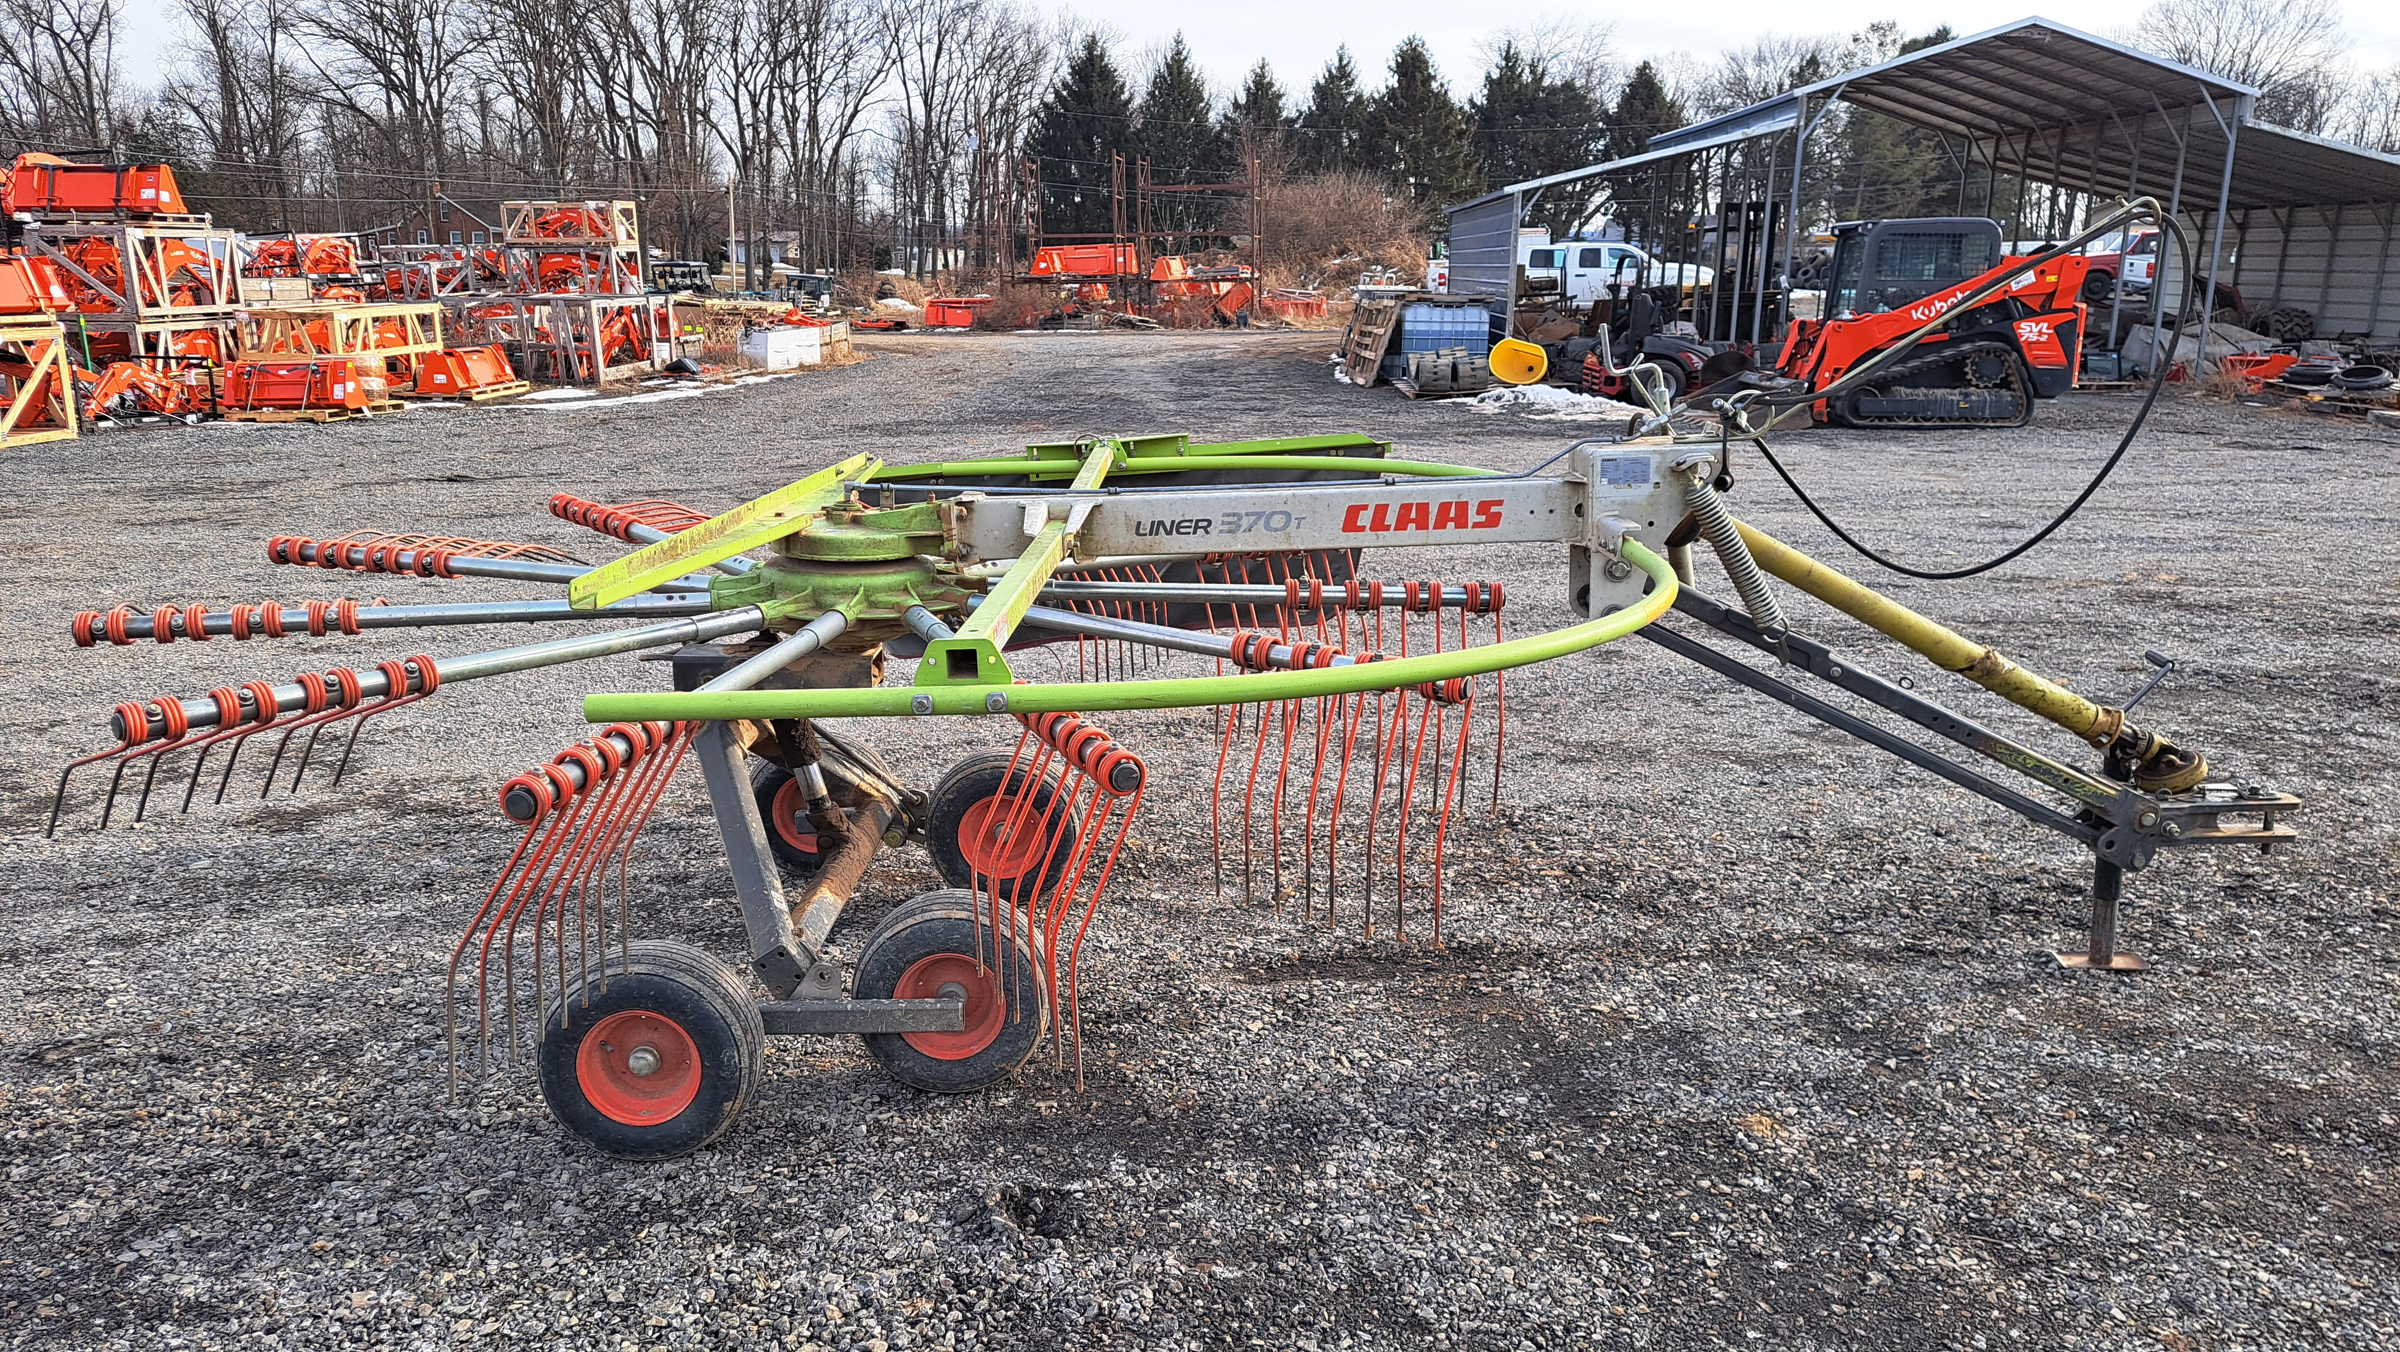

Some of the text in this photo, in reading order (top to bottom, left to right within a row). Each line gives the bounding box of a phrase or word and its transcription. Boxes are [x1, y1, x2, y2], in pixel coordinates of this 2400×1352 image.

[1911, 290, 1971, 321] Kubot
[2017, 321, 2054, 333] SVL
[2020, 332, 2049, 342] 75-2
[1341, 499, 1505, 533] CLAAS
[1135, 518, 1213, 537] LINER
